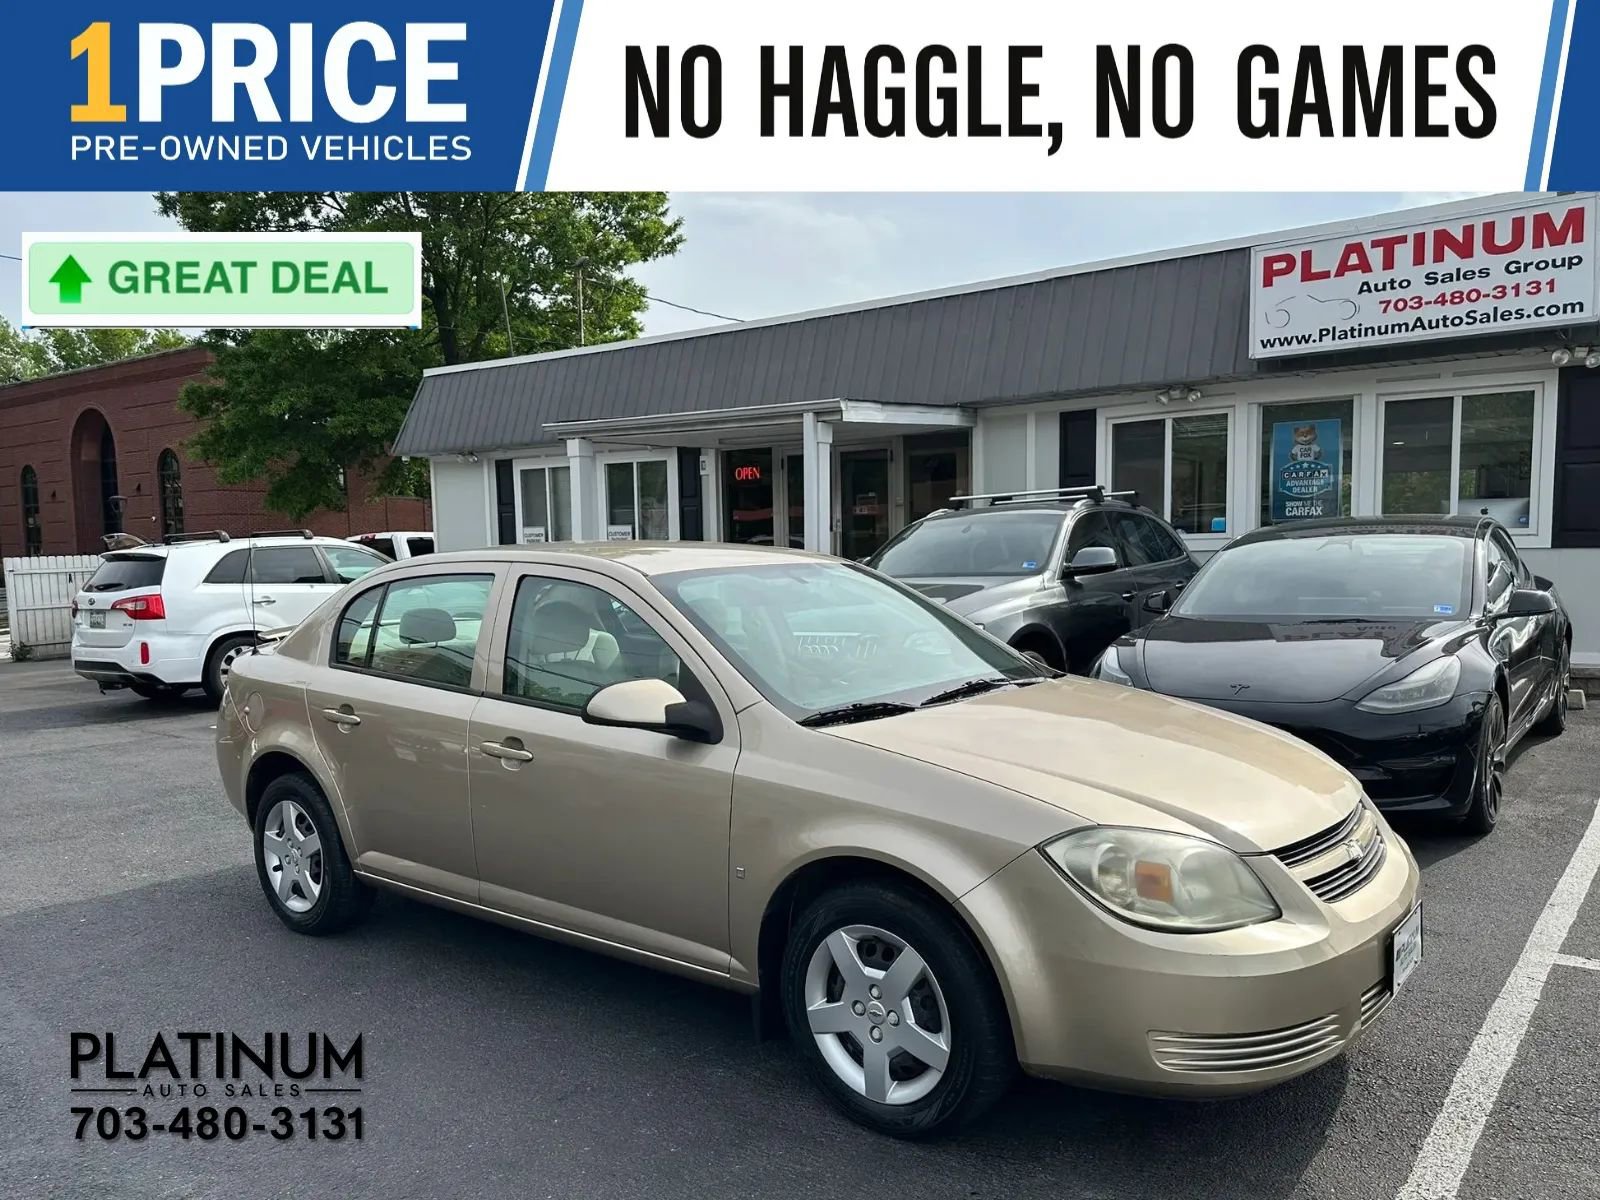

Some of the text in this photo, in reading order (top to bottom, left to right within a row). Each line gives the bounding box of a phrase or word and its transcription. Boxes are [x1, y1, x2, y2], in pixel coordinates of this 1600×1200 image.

[1262, 206, 1586, 288] PLATINUM
[1357, 253, 1584, 295] Auto Sales Group
[1378, 278, 1556, 314] 703-480-3131
[1259, 300, 1585, 350] www.PlatinumAutoSales.com
[735, 466, 760, 480] OPEN
[1284, 470, 1329, 479] CARFAX
[1286, 479, 1325, 487] ADVANTAGE
[1285, 507, 1323, 516] CARFAX
